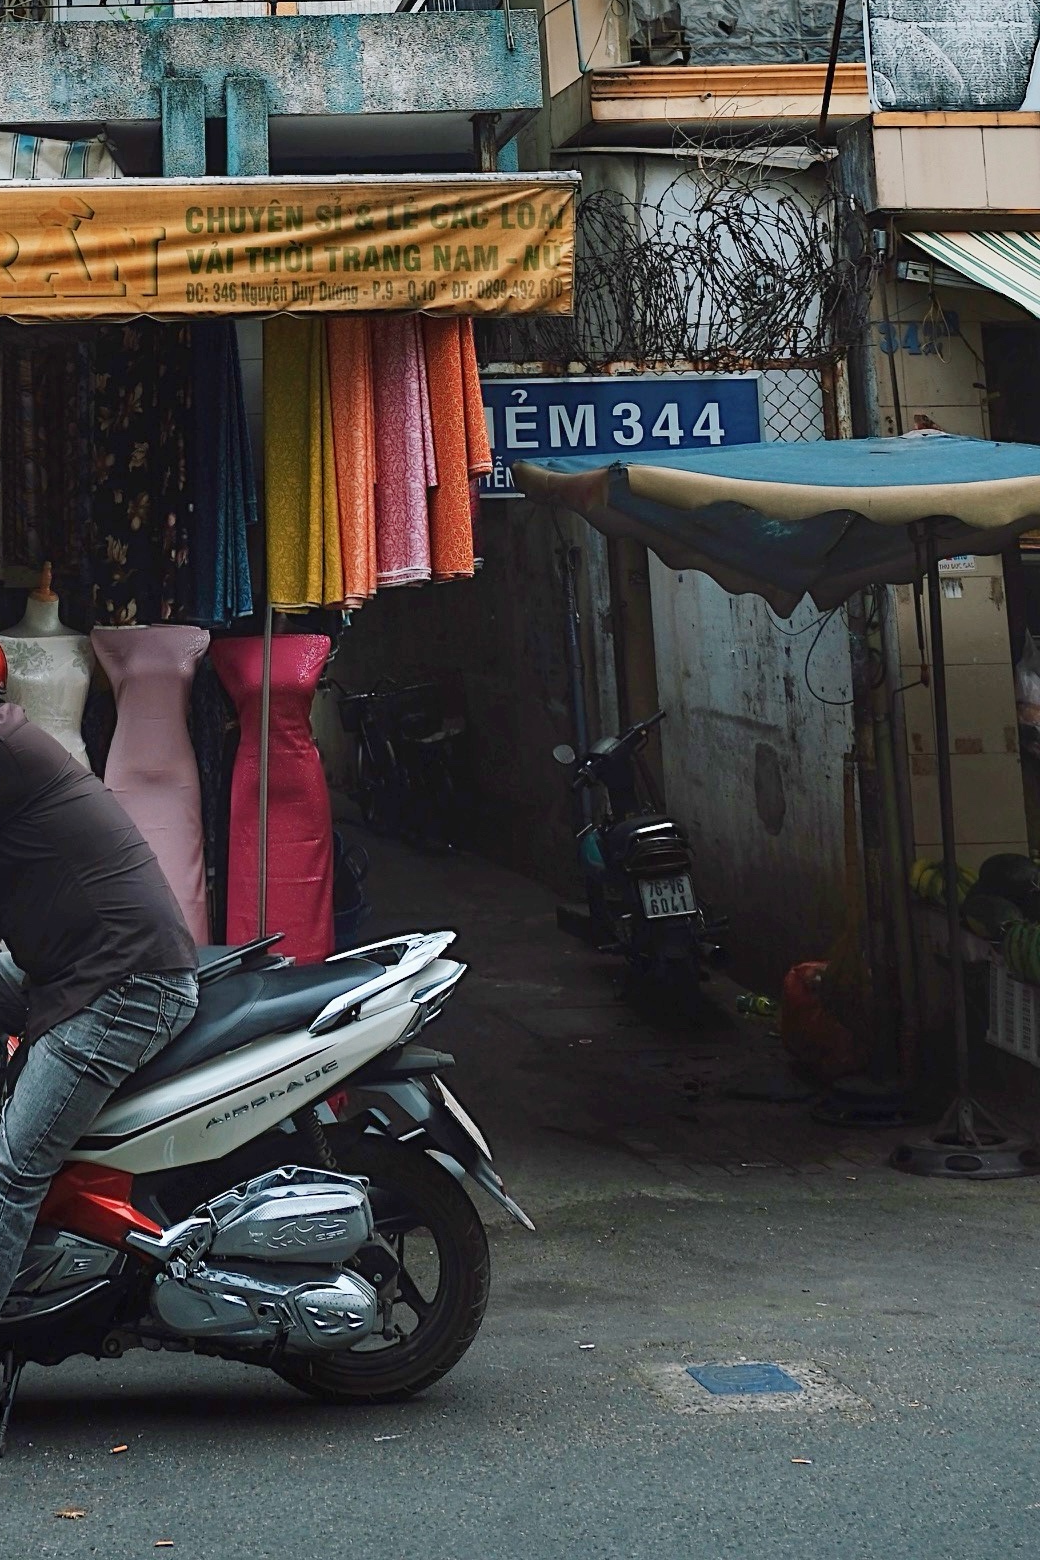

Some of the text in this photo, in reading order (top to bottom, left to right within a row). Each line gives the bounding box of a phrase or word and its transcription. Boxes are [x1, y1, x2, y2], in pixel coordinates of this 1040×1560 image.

[185, 199, 303, 234] CHUYÊN
[315, 197, 342, 231] SỈ
[354, 204, 375, 231] &
[386, 196, 418, 230] LẺ
[185, 241, 234, 274] VẢI
[245, 240, 313, 273] THỜI
[324, 244, 422, 273] TRANG
[433, 244, 499, 272] NAM
[186, 282, 209, 304] ĐC:
[213, 282, 237, 303] 346
[241, 278, 287, 306] Nguyễn
[292, 280, 315, 306] Duy
[319, 280, 358, 305] Dương
[372, 280, 393, 301] P.9
[483, 389, 725, 450] ẺM 344
